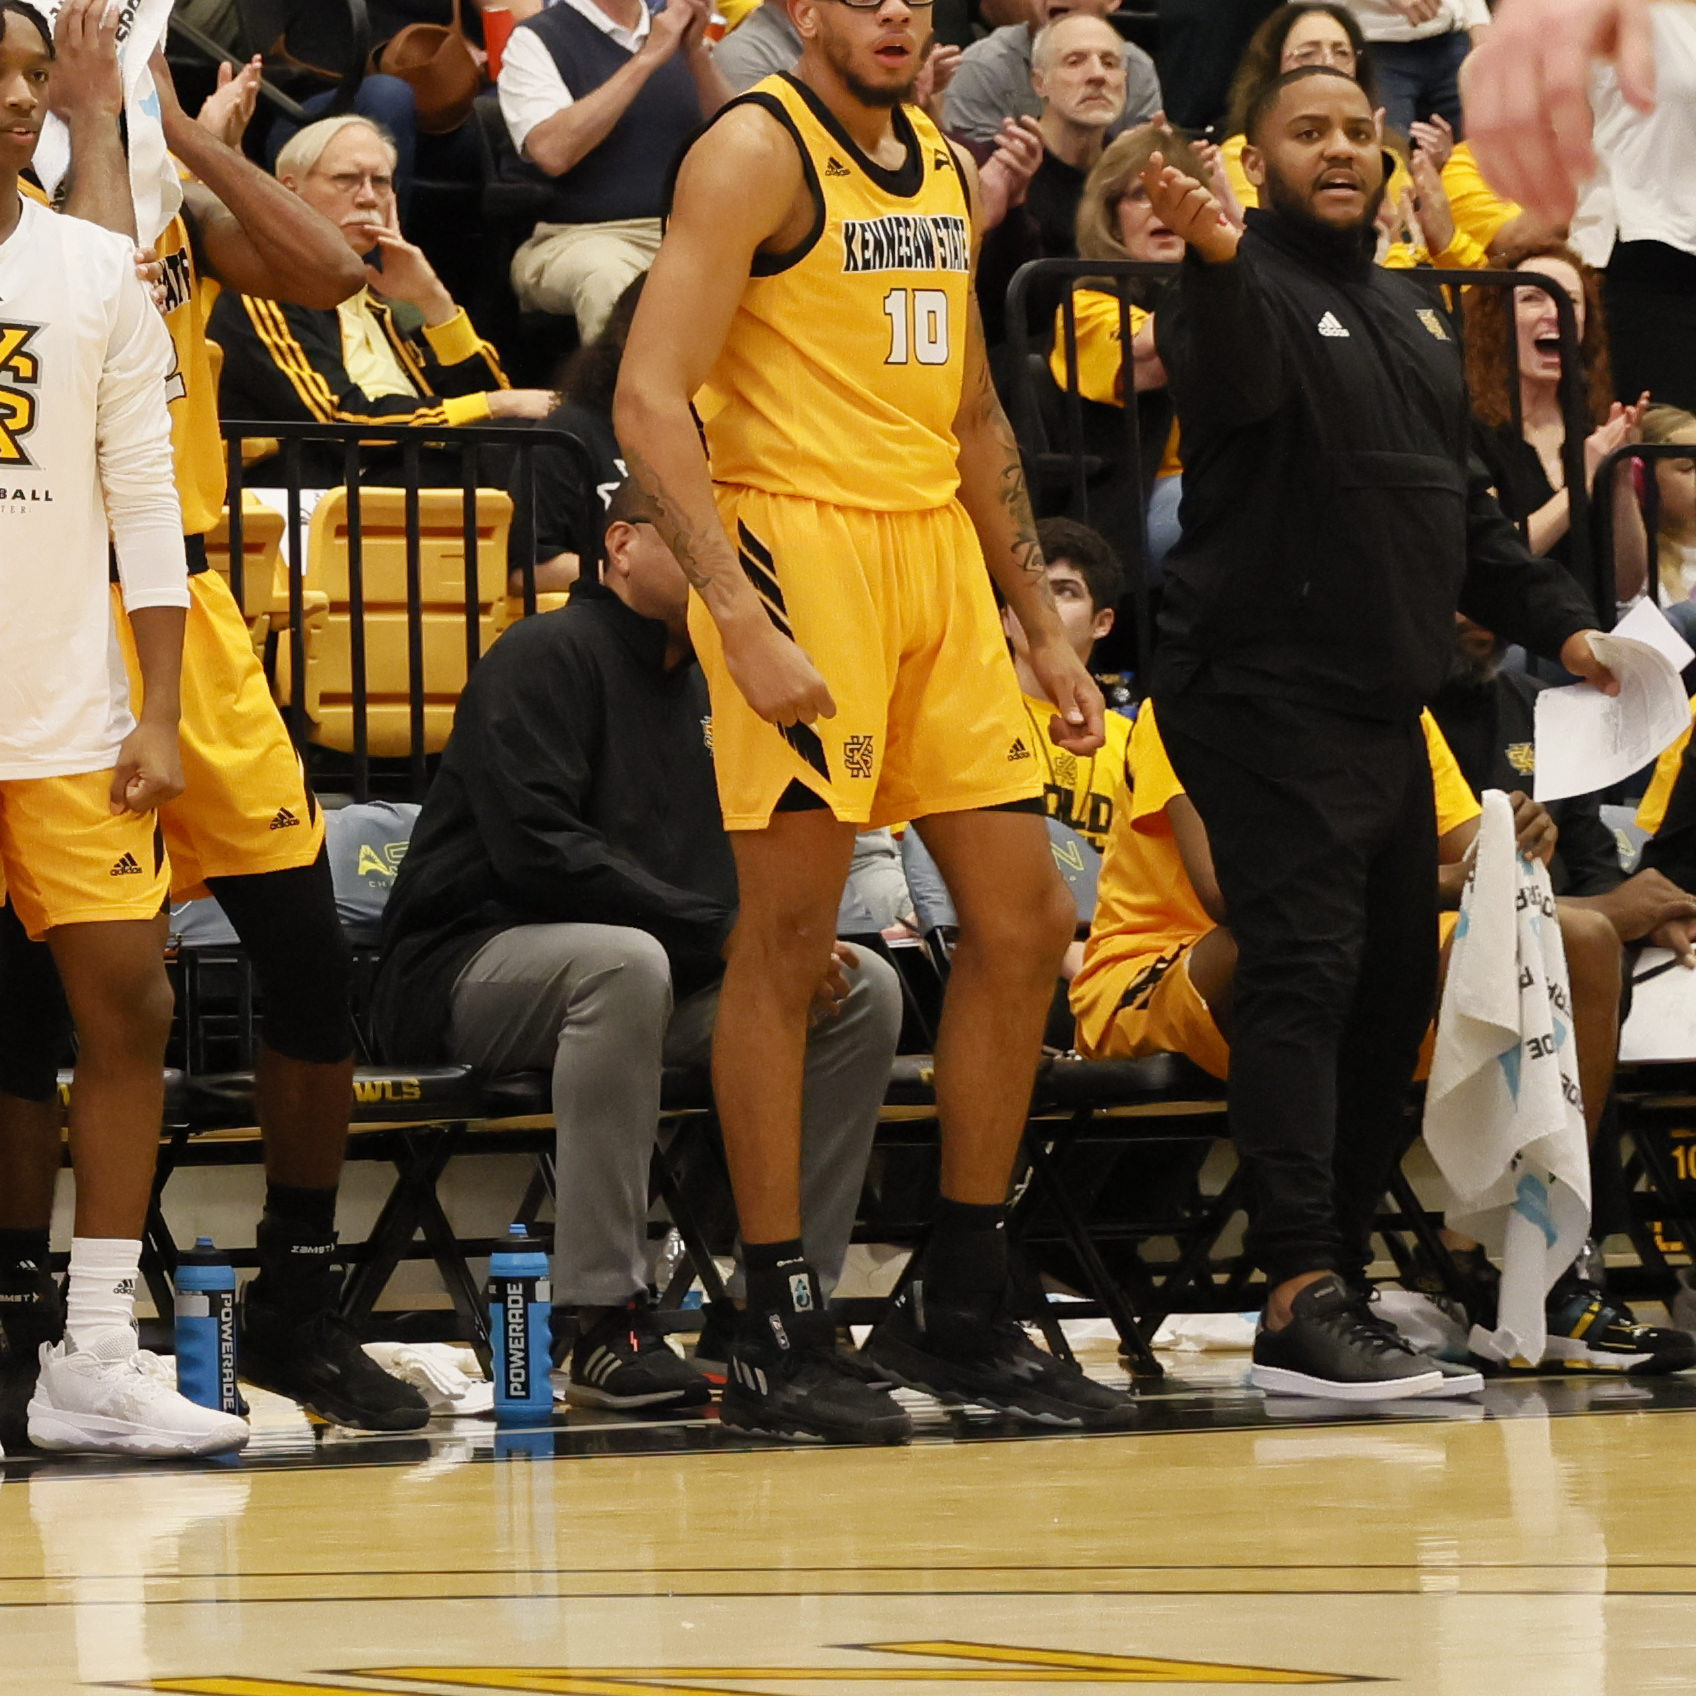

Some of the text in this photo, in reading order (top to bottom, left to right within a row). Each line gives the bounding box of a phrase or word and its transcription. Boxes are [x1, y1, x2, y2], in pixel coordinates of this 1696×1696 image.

[843, 216, 936, 271] KENNESAW
[884, 288, 949, 365] 10
[352, 1077, 421, 1103] WLS
[217, 1292, 237, 1412] POWERADE
[507, 1281, 527, 1400] POWERADE
